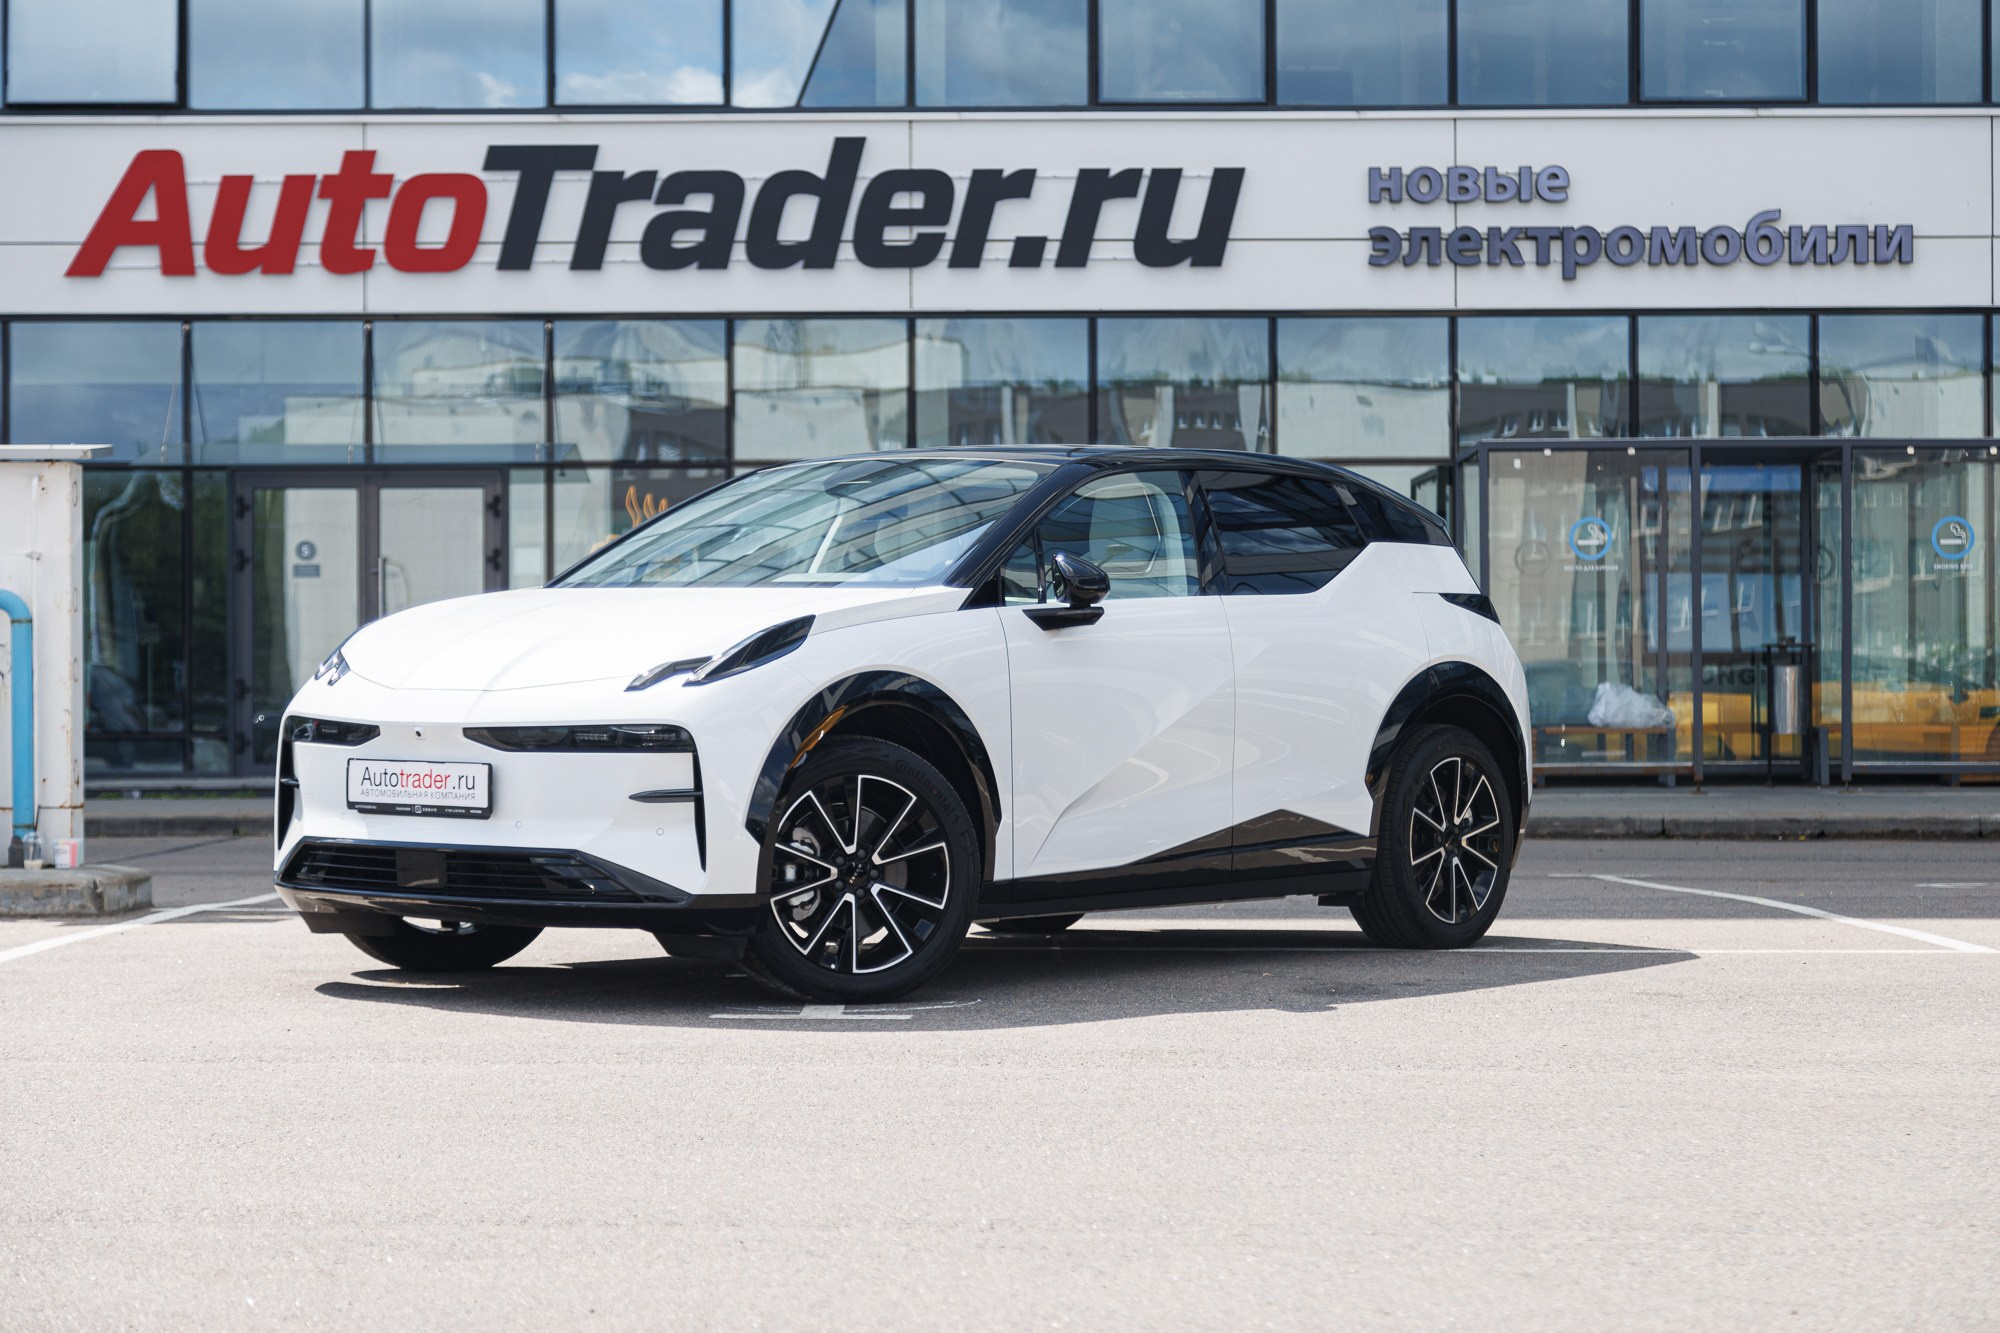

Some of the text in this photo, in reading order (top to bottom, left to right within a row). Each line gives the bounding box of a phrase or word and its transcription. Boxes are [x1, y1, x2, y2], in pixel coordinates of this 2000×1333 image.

[1367, 164, 1571, 203] новые
[64, 136, 1246, 277] AutoTrader.ru
[1367, 208, 1915, 280] электромобили
[360, 766, 476, 791] Autotrader.ru
[360, 788, 476, 801] АВТОМОБИЛЬНАЯ КОМПАНИЯ
